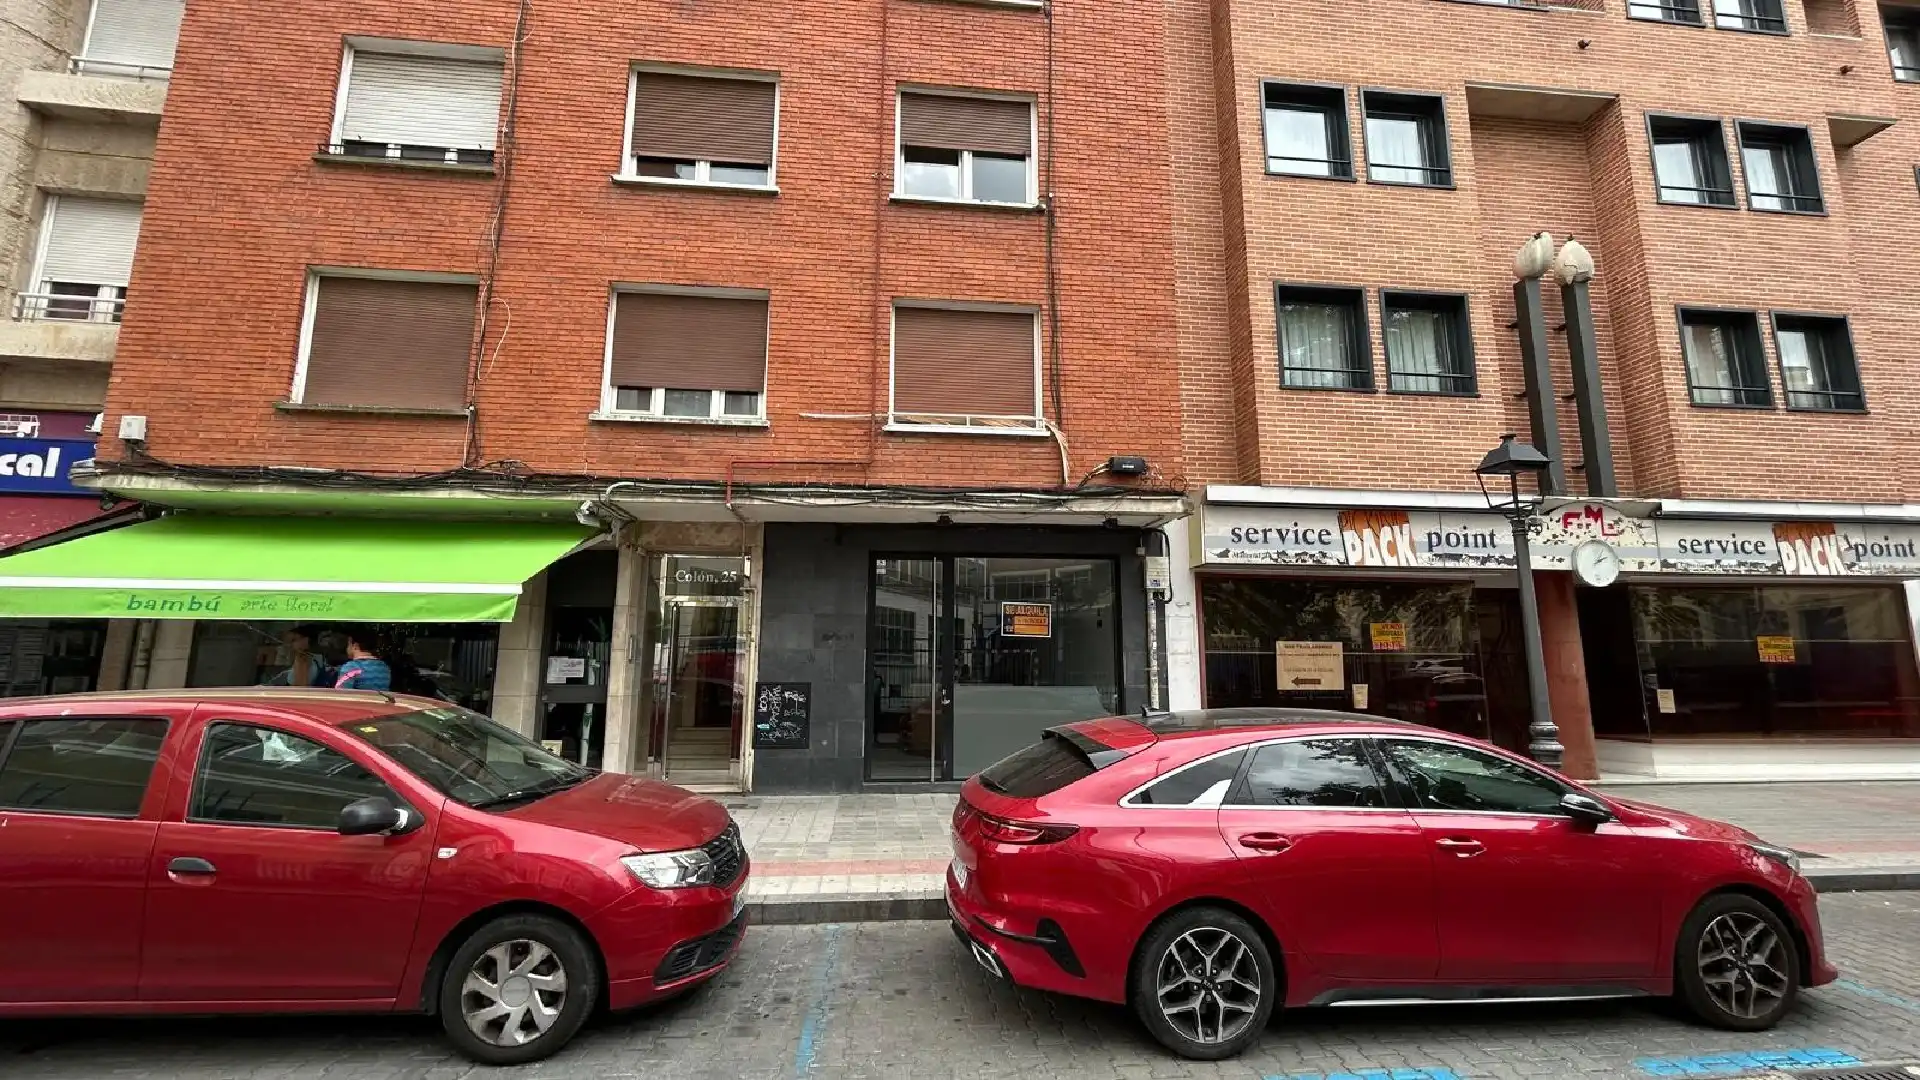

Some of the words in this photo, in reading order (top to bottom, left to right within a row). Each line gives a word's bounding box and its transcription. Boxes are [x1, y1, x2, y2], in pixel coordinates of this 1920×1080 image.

[1230, 522, 1332, 545] service
[1342, 524, 1418, 566] PACK
[1428, 526, 1497, 552] point
[1678, 533, 1766, 554] service
[1777, 534, 1847, 575] PACK
[1854, 535, 1915, 561] point
[721, 570, 737, 583] 25
[127, 595, 221, 612] bambú
[1005, 605, 1015, 615] SE
